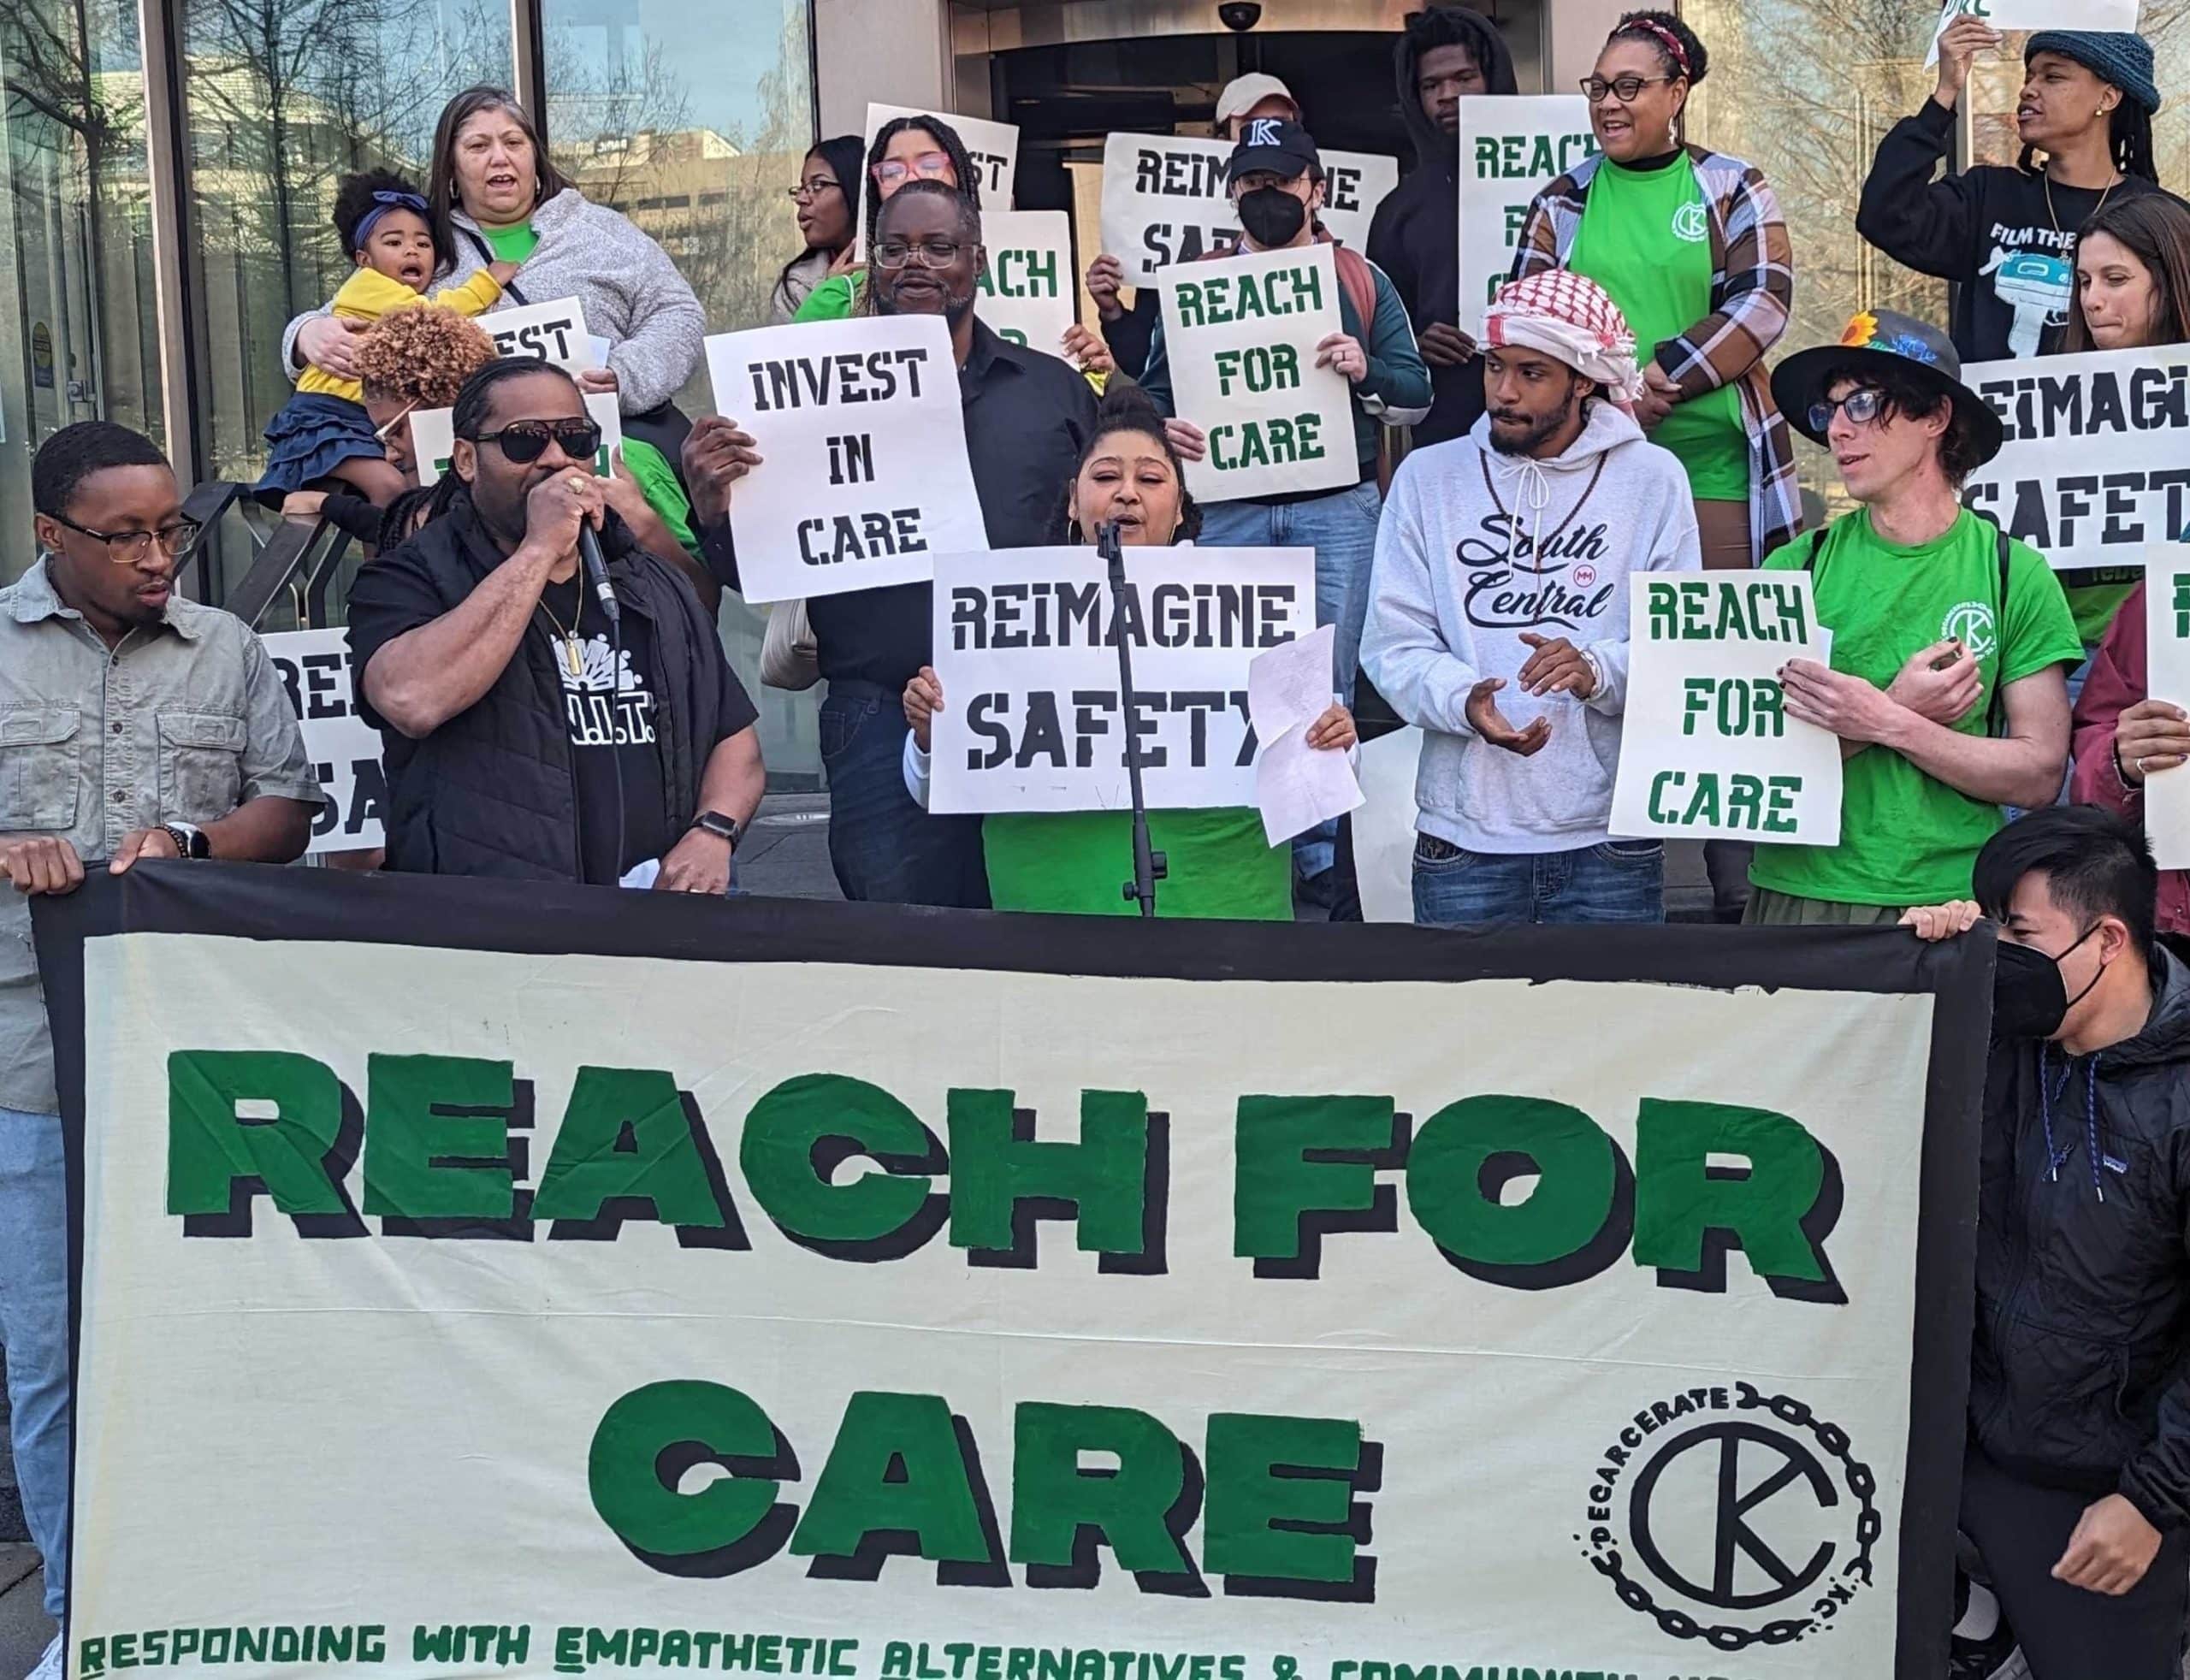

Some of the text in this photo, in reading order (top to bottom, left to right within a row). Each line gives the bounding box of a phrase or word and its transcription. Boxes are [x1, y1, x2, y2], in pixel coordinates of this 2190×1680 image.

[1990, 222, 2033, 246] FILM
[1175, 265, 1323, 328] REACH
[749, 348, 927, 411] INVEST
[1215, 343, 1300, 396] FOR
[826, 434, 874, 485] IN
[1209, 413, 1325, 470] CARE
[797, 508, 928, 565] CARE
[1456, 513, 1609, 574] South
[951, 583, 1296, 650] REIMAGINE
[1464, 570, 1614, 631] Central
[1648, 583, 1808, 645] REACH
[1683, 678, 1785, 736] FOR
[1648, 771, 1802, 833] CARE
[166, 1050, 1849, 1304] REACH FOR
[588, 1379, 1383, 1603] CARE
[1588, 1387, 1730, 1543] DECARCERATE
[80, 1625, 386, 1680] RESPONDING
[412, 1625, 531, 1666] WITH
[554, 1626, 859, 1677] EMPATHETIC
